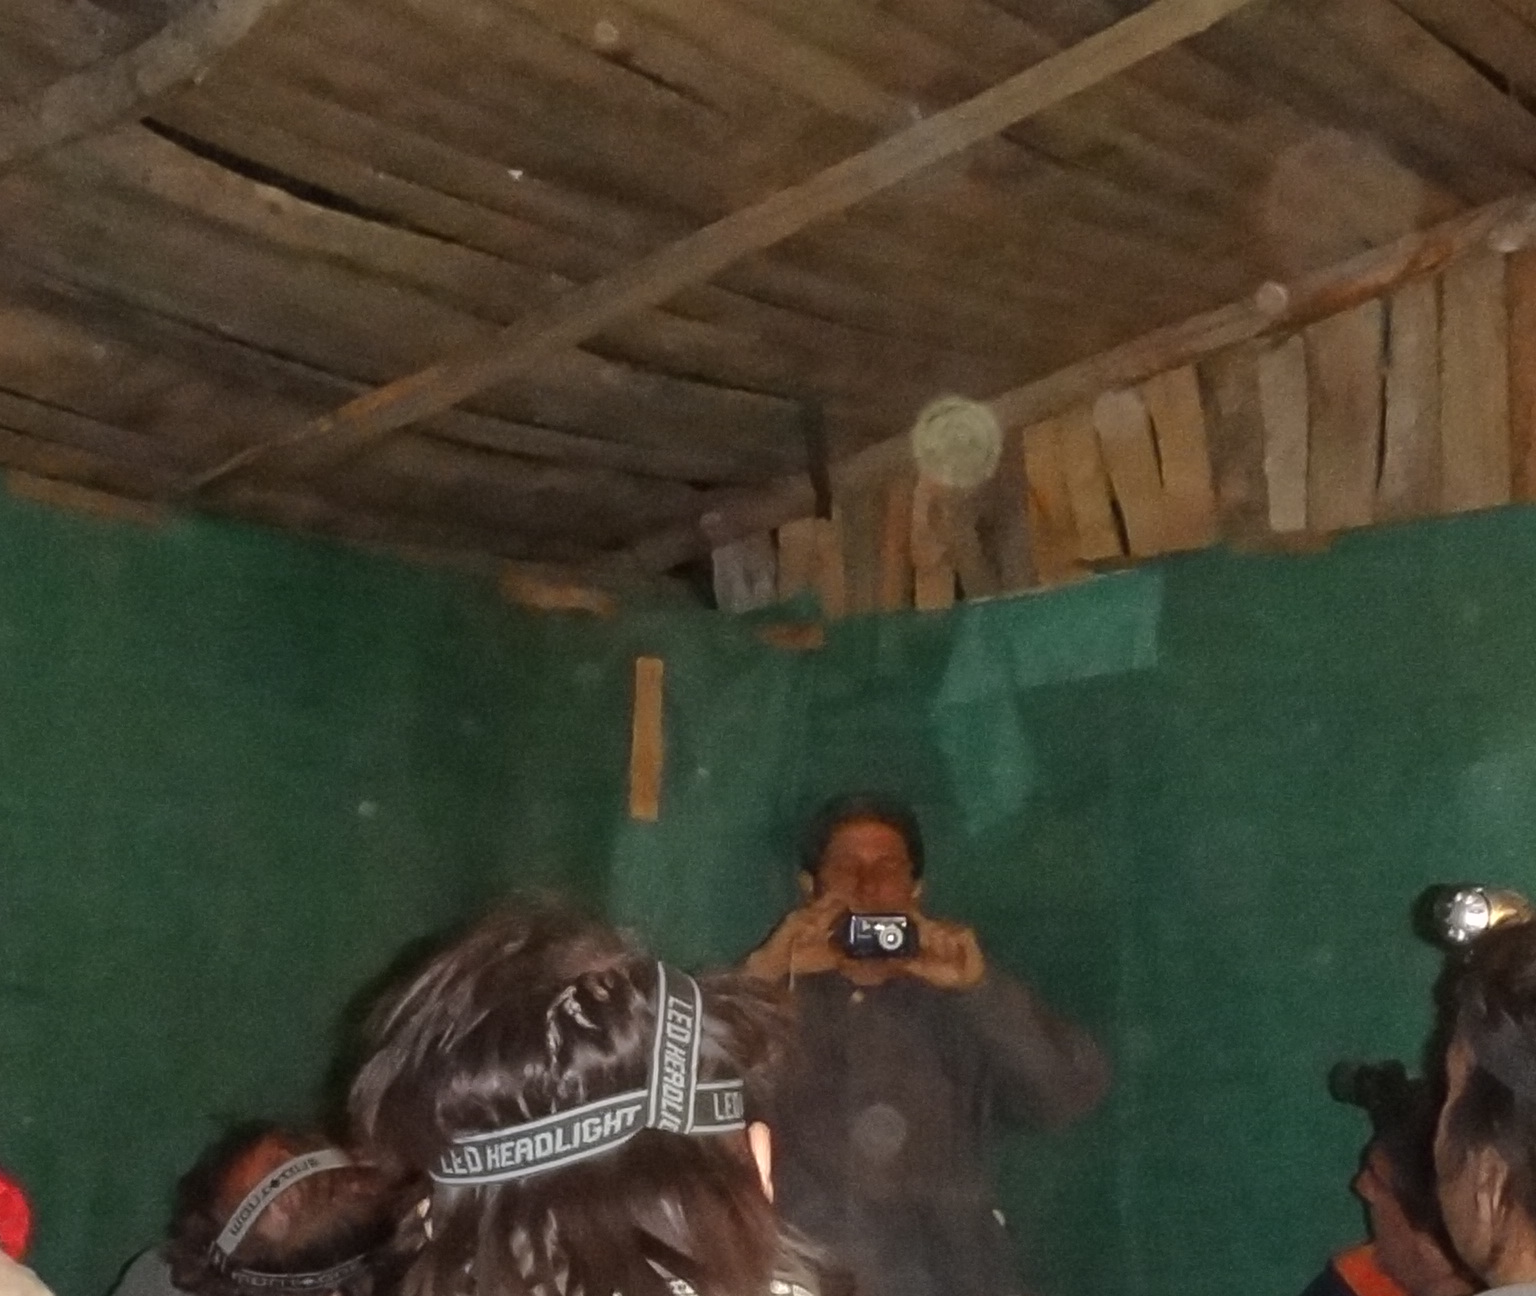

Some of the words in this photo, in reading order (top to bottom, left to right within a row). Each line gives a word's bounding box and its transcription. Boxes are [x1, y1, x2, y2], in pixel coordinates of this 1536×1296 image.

[666, 995, 693, 1044] LED
[440, 1146, 483, 1175] LED
[486, 1104, 642, 1171] HEADLIGHT
